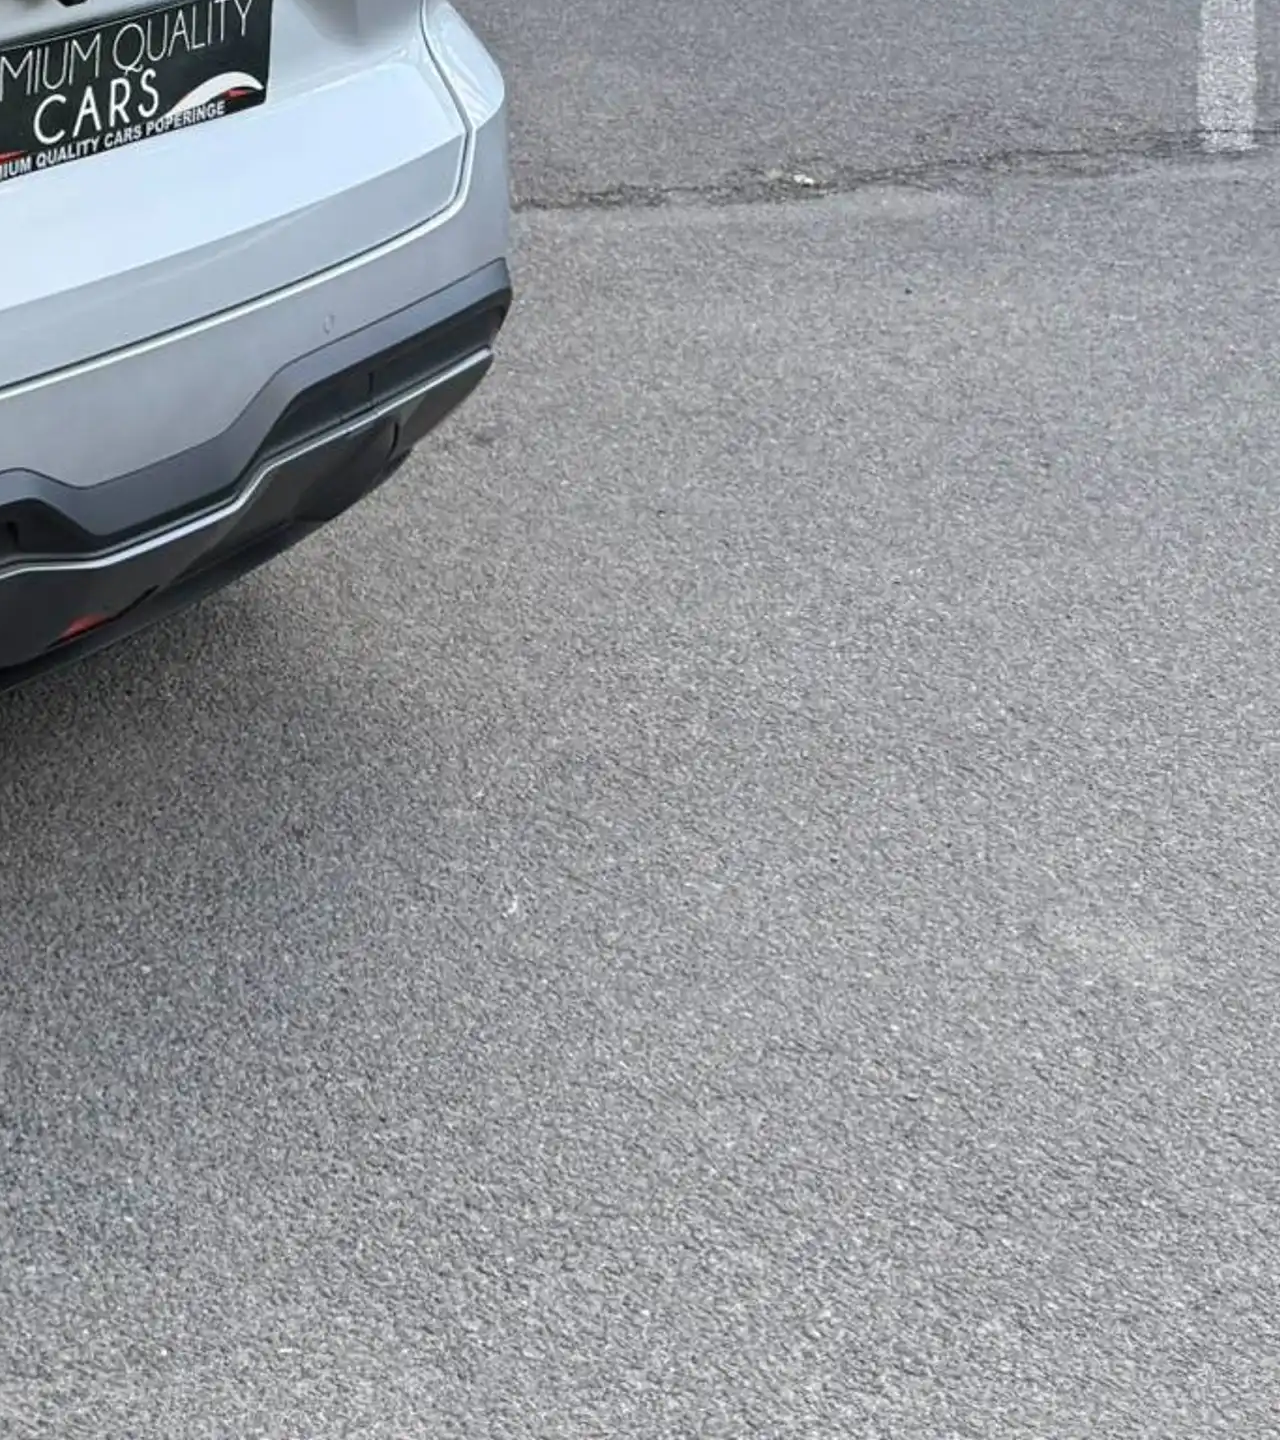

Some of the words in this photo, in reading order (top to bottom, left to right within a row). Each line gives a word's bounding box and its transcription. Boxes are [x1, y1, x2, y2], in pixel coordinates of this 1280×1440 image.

[33, 67, 160, 145] CARS
[36, 136, 100, 168] QUALITY
[104, 124, 143, 148] CARS
[145, 101, 227, 137] POPERINGE
